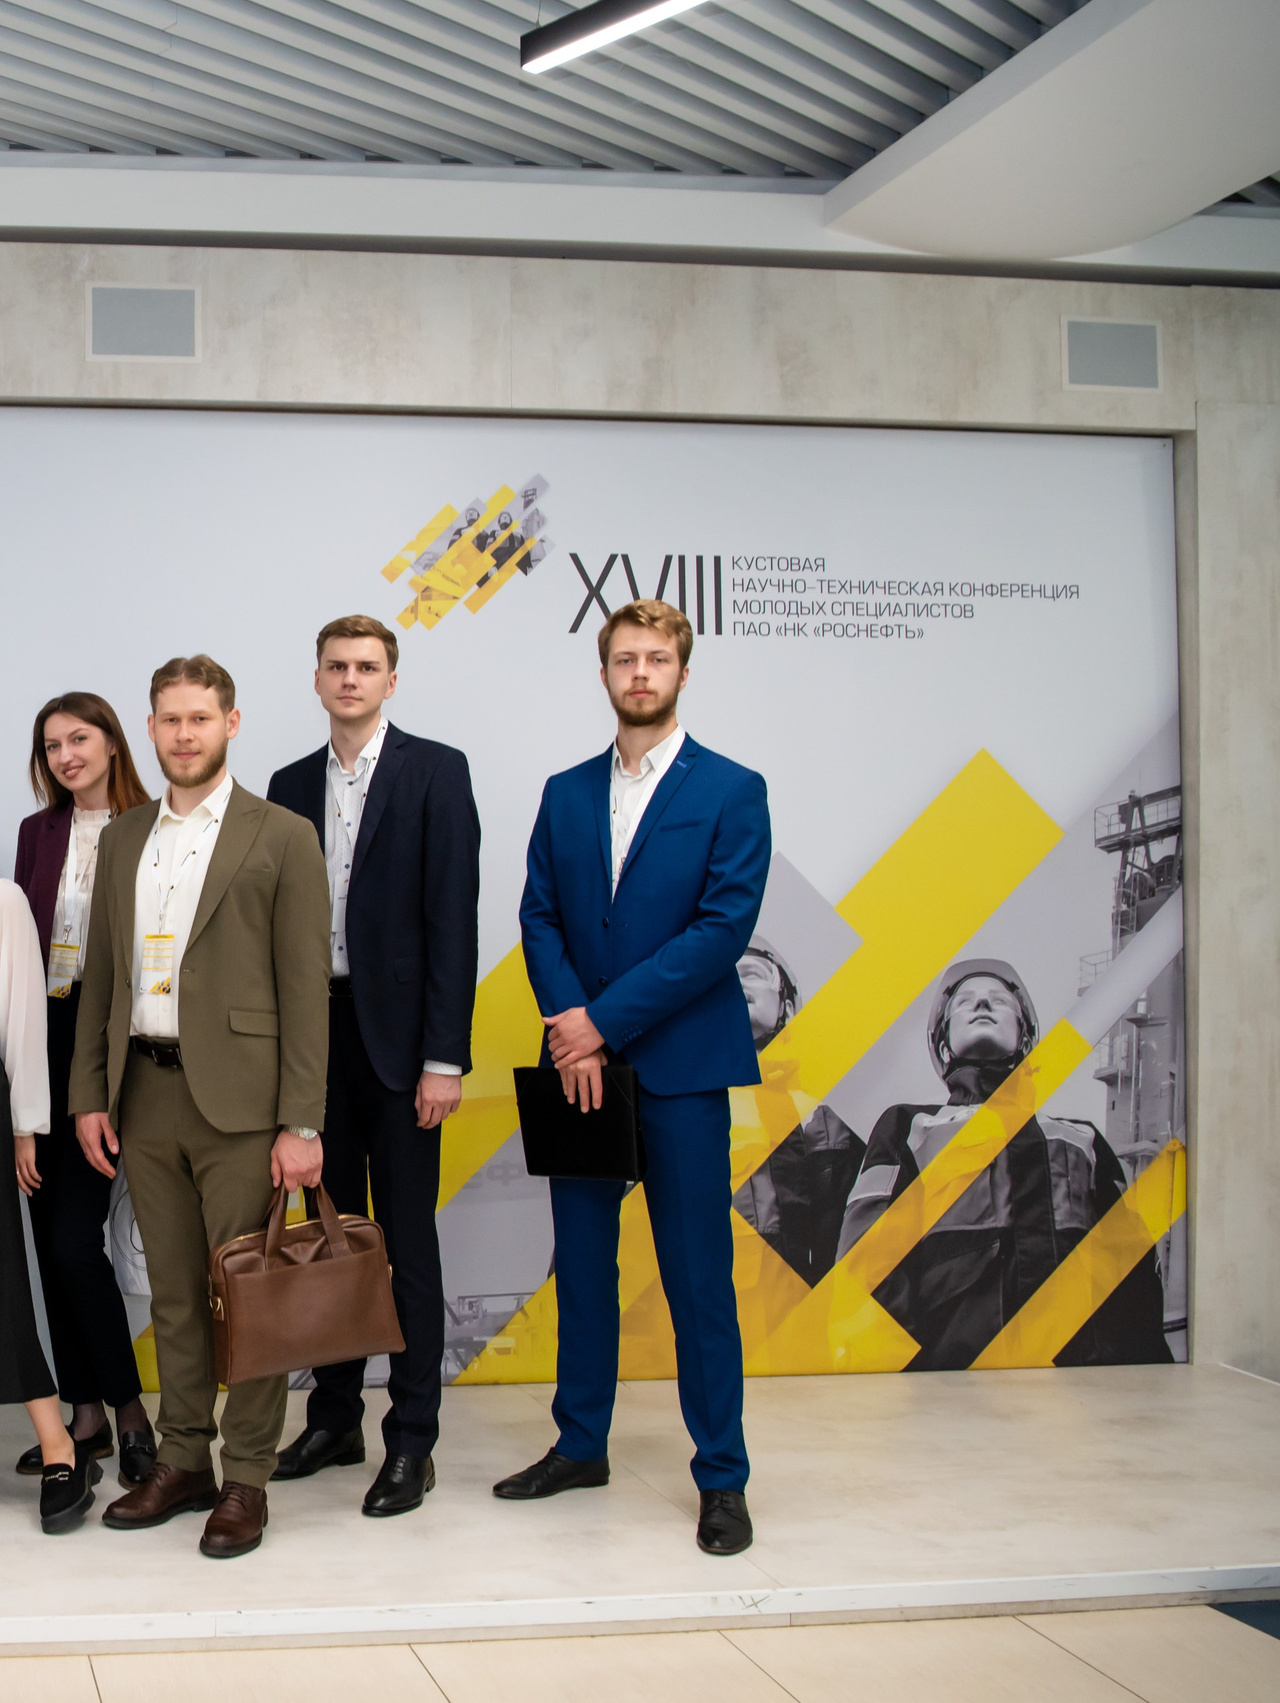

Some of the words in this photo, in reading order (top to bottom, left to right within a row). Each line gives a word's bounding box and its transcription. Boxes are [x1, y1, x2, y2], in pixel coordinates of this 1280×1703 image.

[732, 555, 826, 572] КУСТОВАЯ
[569, 553, 722, 635] XVIII
[732, 578, 944, 597] НАУЧНО-ТЕХНИЧЕСКАЯ
[949, 583, 1080, 602] КОНФЕРЕНЦИЯ
[732, 600, 827, 617] МОЛОДЫХ
[831, 601, 975, 619] СПЕЦИАЛИСТОВ
[733, 621, 771, 637] ПАО
[775, 622, 808, 637] «НК
[813, 622, 924, 639] «РОСНЕФТЬ»
